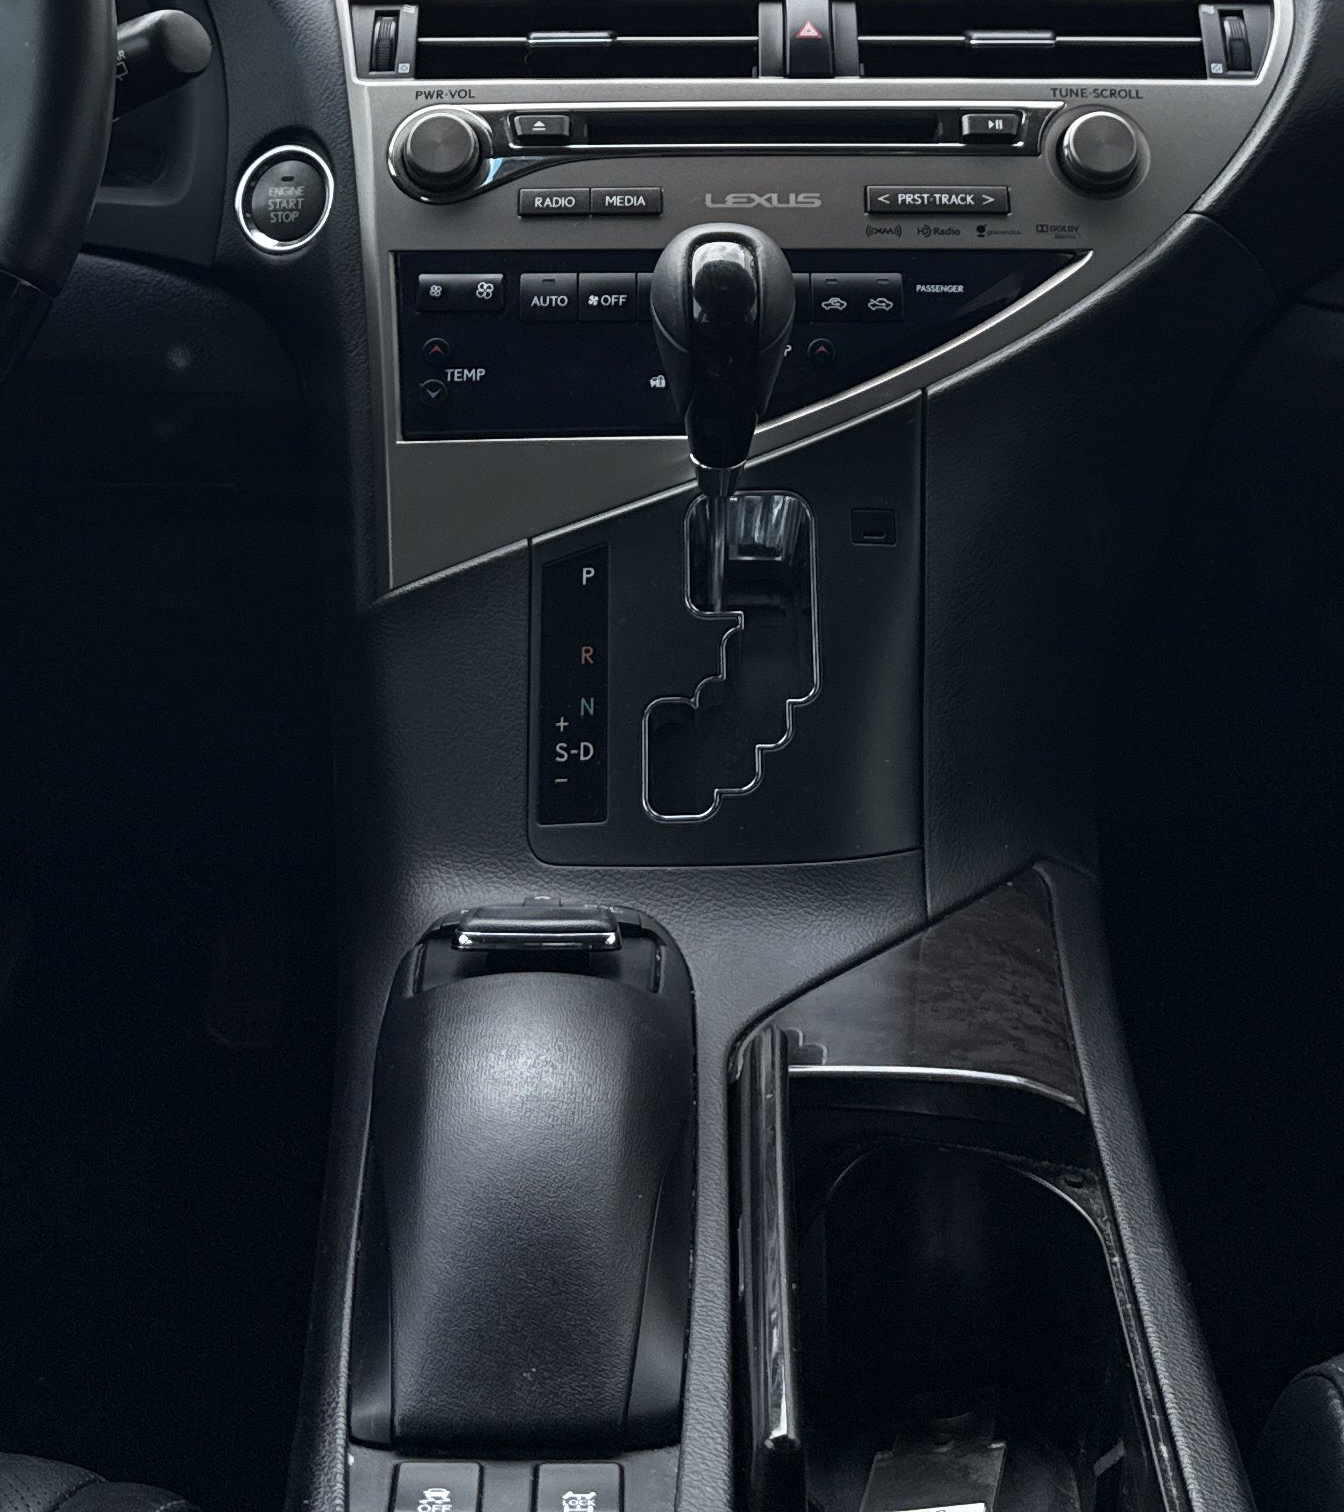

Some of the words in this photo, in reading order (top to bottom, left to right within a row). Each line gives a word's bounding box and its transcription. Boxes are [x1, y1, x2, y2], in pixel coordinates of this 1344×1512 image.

[268, 186, 304, 197] ENGINE
[267, 198, 304, 210] START
[534, 196, 576, 208] RADIO
[605, 195, 646, 207] MEDIA
[705, 193, 822, 208] LEXUS
[270, 210, 299, 223] STOP
[933, 225, 960, 236] Radio
[916, 284, 964, 293] PASSENGER
[531, 295, 568, 307] AUTO
[601, 295, 627, 306] OFF
[445, 368, 485, 382] TEMP
[582, 567, 595, 585] P
[581, 646, 594, 665] R
[580, 697, 594, 716] N
[563, 1499, 596, 1507] LOCK
